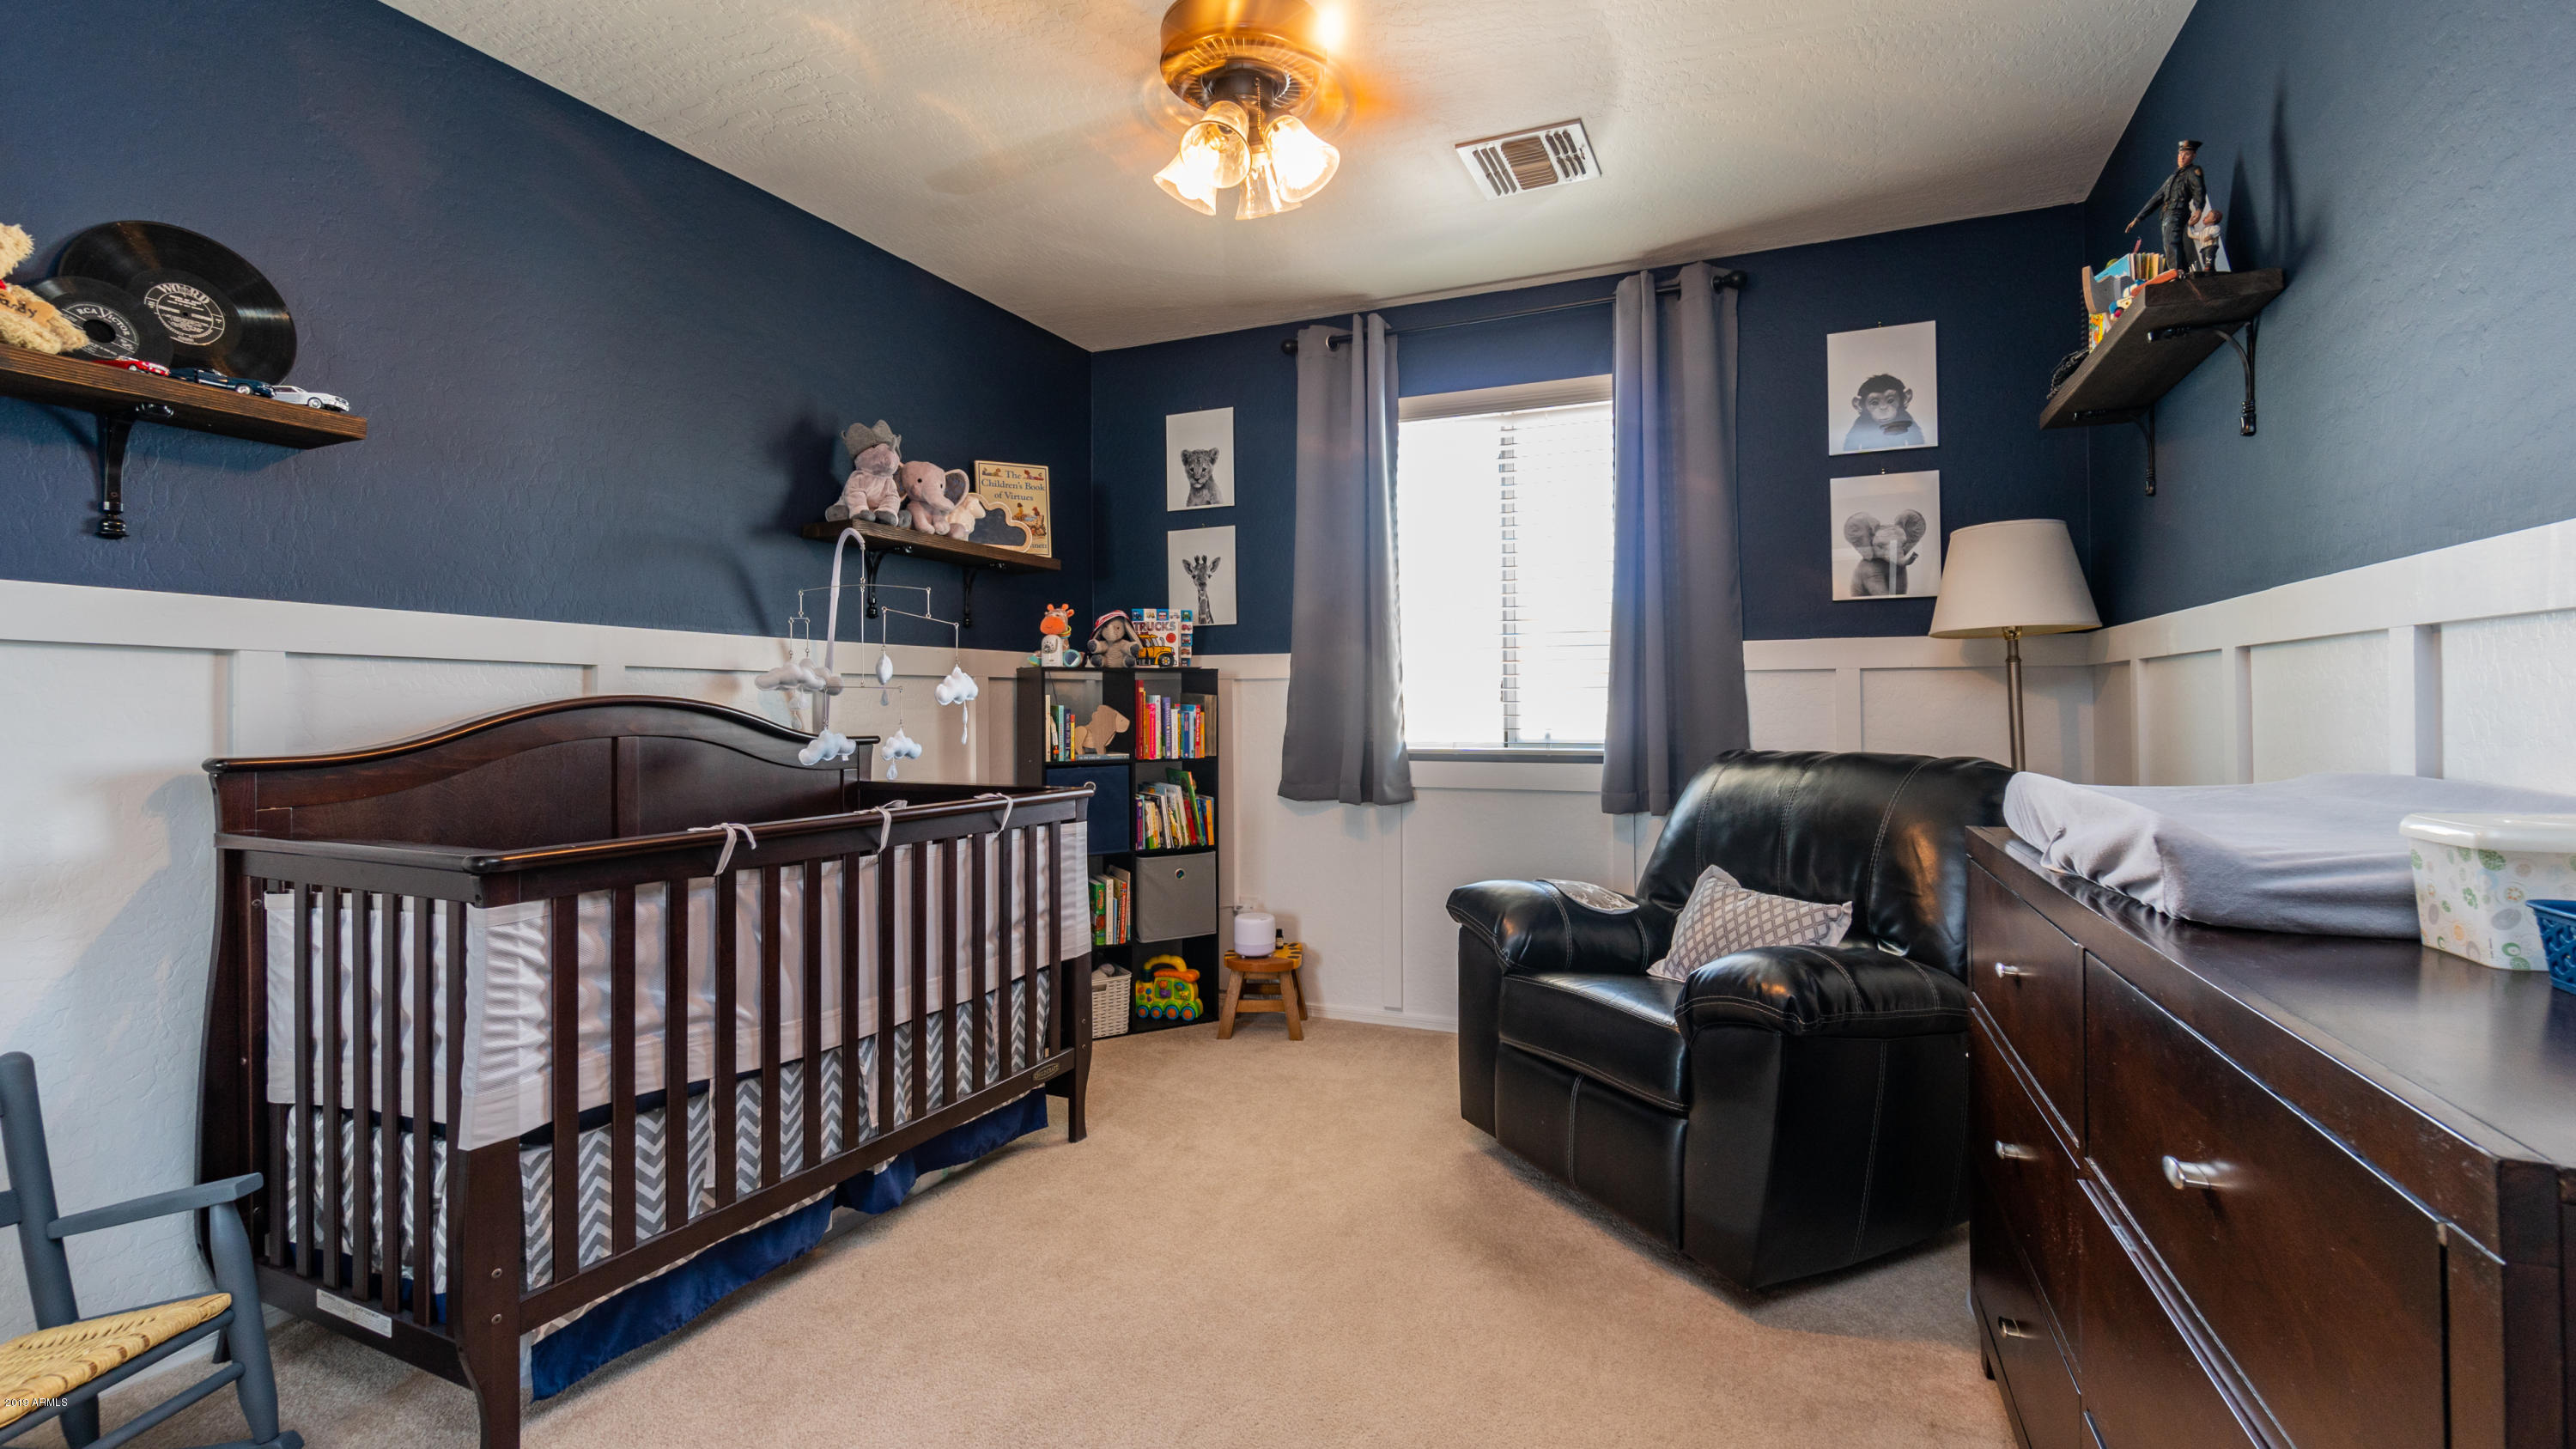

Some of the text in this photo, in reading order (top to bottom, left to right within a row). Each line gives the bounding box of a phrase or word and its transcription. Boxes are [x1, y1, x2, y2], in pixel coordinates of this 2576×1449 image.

[155, 283, 210, 303] WORD
[99, 307, 131, 336] VICTOR
[1005, 470, 1022, 479] The
[981, 478, 1045, 491] Children's Book
[1005, 492, 1034, 501] Virtues
[1133, 621, 1176, 631] TRUCKS
